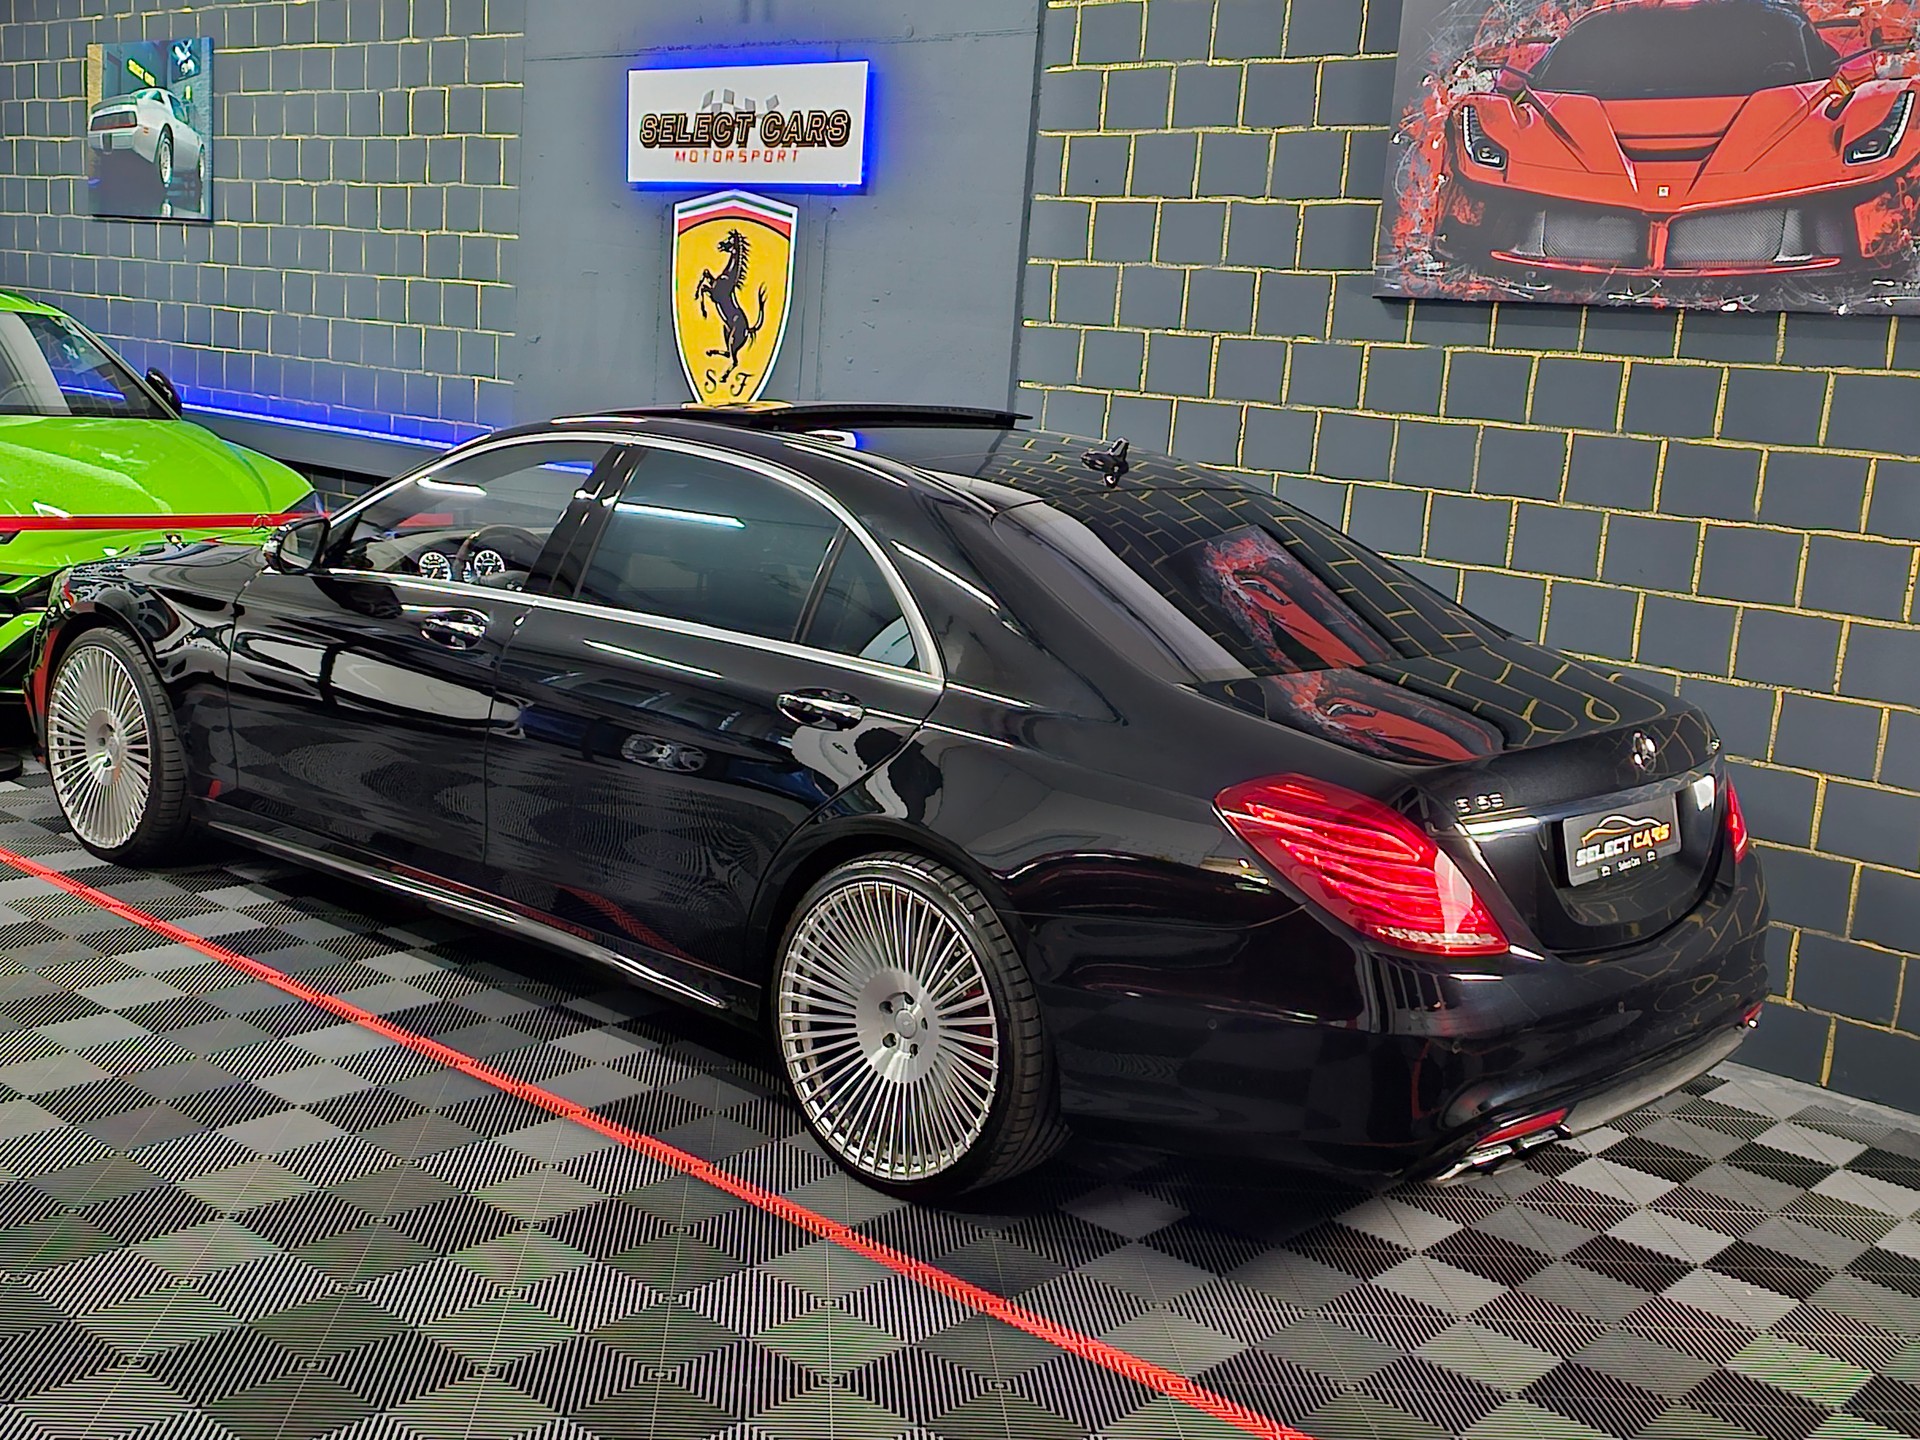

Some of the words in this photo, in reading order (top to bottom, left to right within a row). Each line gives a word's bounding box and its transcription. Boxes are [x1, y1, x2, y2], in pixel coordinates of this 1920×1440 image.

[640, 111, 755, 148] SELECT
[760, 110, 851, 147] CARS
[674, 149, 799, 163] MOTORSPORT
[704, 369, 717, 394] S
[1576, 835, 1632, 867] SELECT
[1632, 823, 1670, 849] CARS
